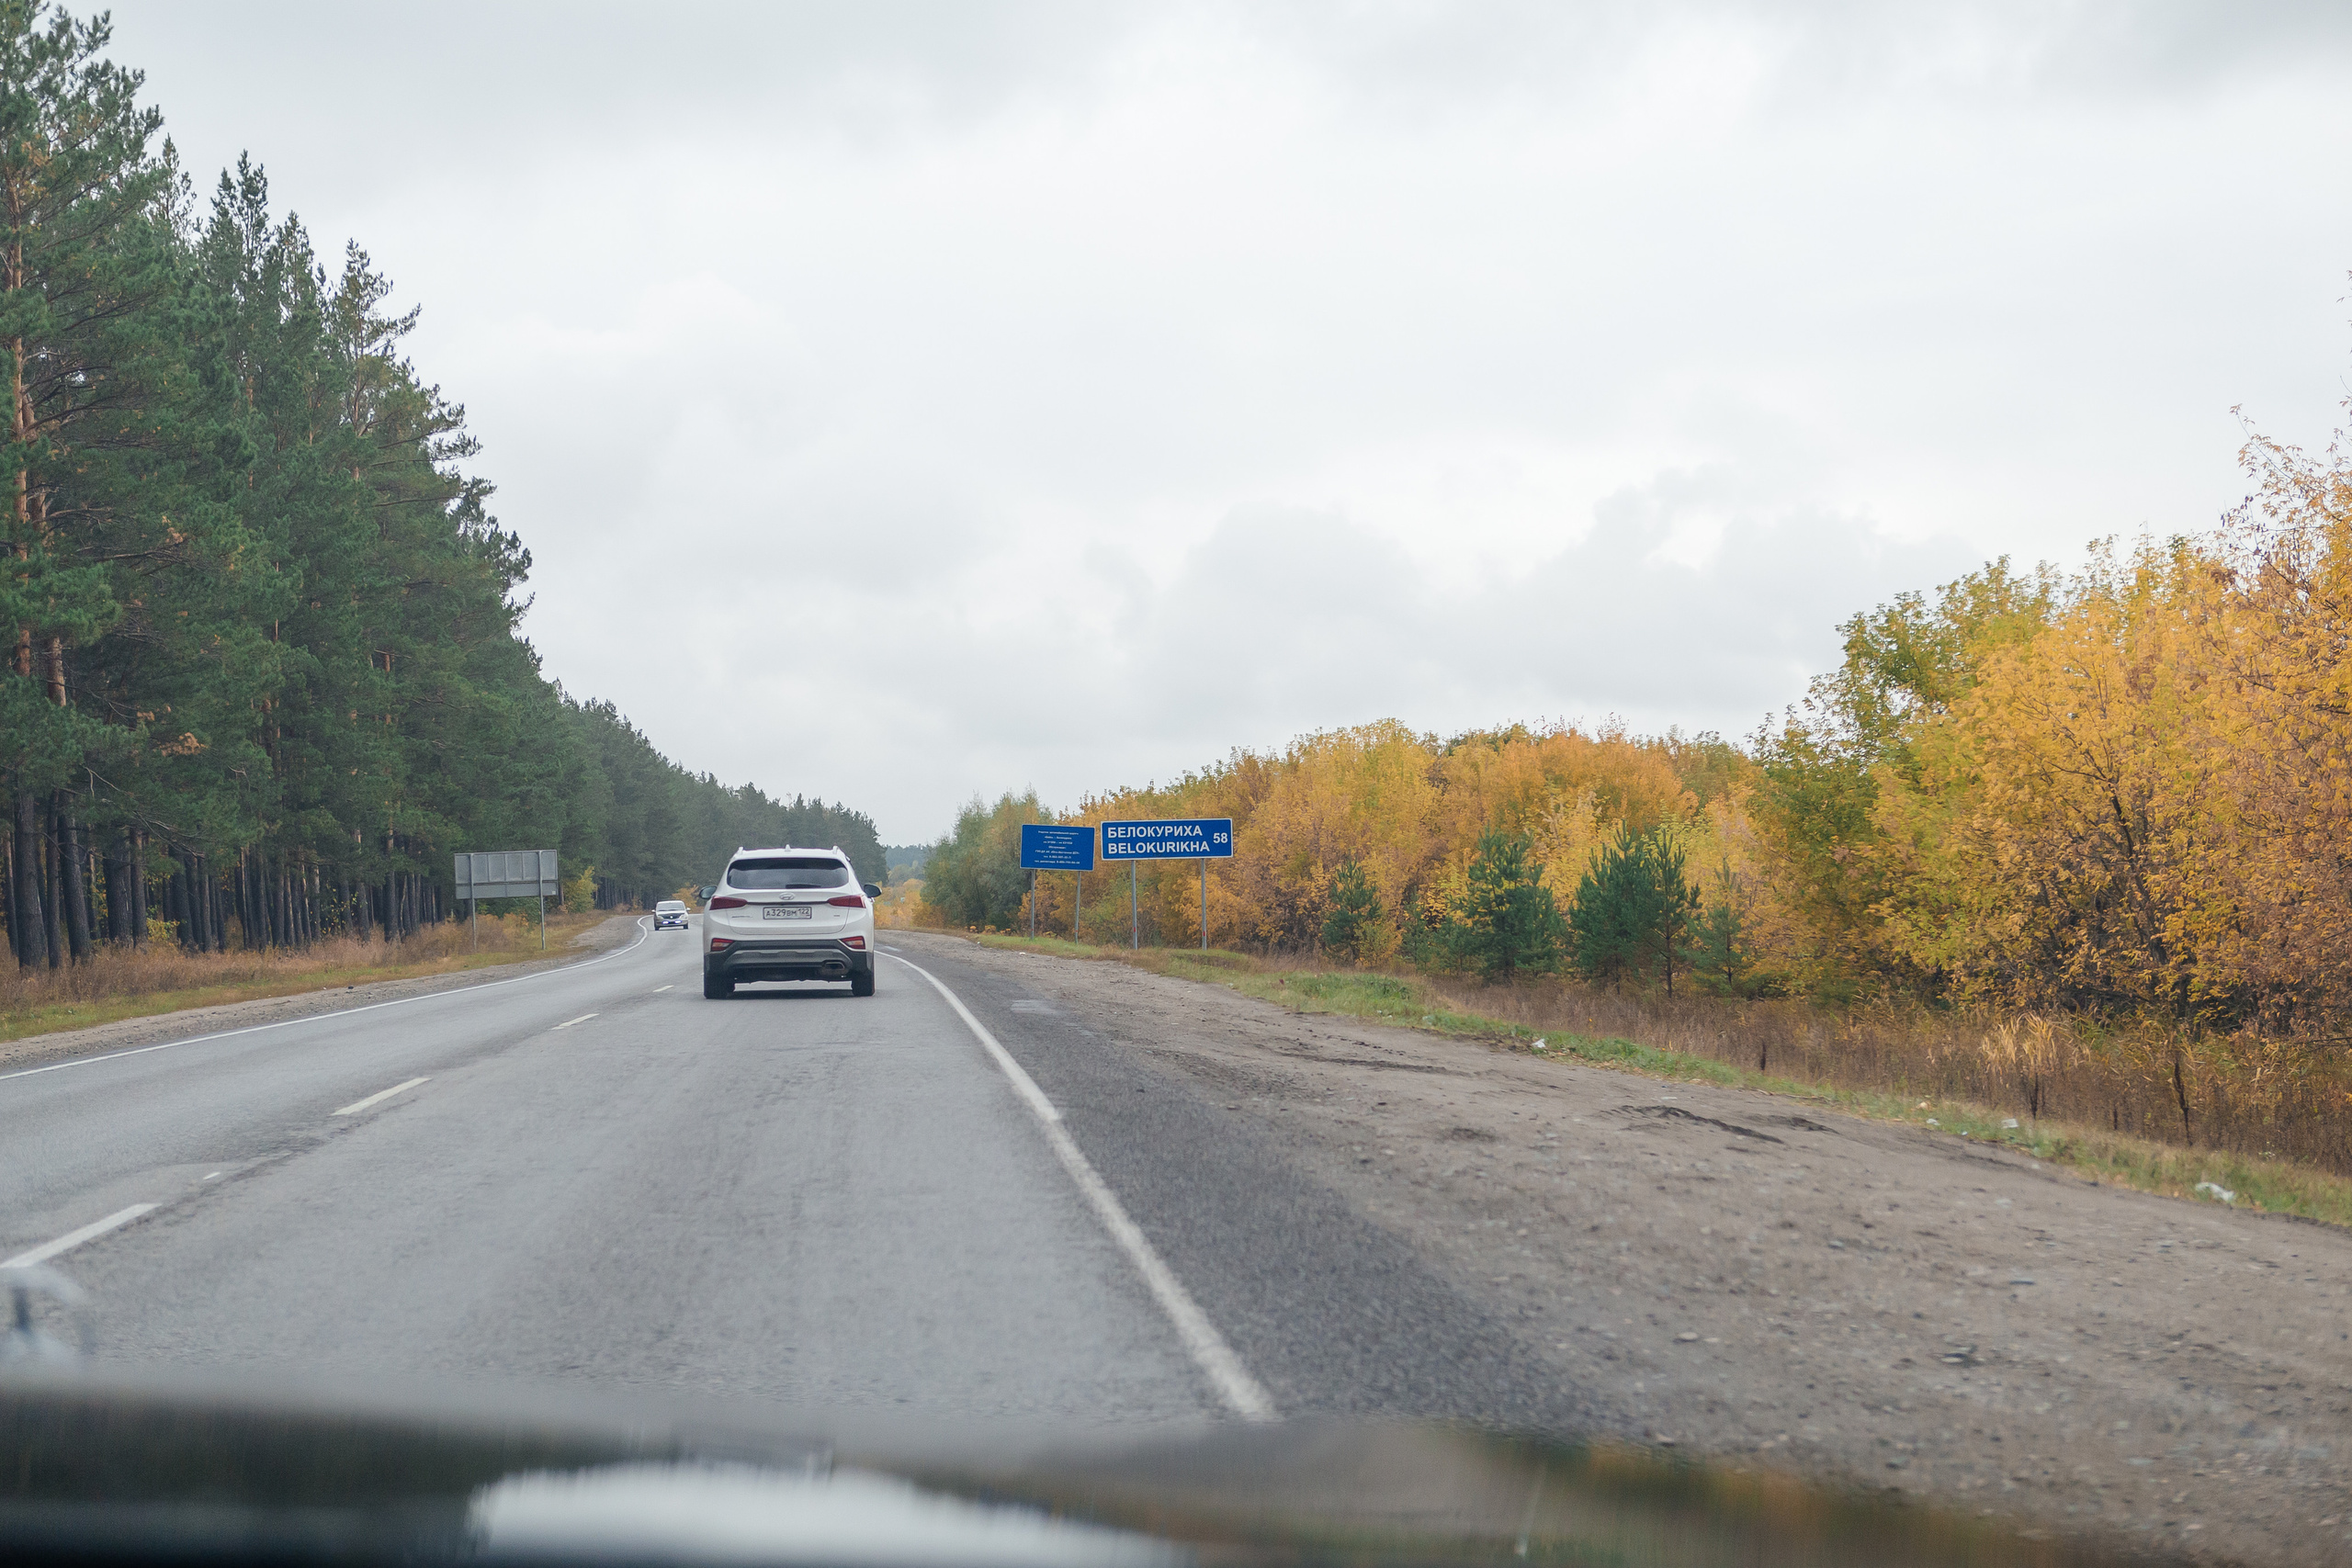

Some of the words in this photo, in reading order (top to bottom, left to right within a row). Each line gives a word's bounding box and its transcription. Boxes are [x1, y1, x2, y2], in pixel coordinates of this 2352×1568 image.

[1107, 825, 1203, 839] БЕЛОКУРИХА
[1213, 832, 1228, 844] 58
[1108, 840, 1210, 854] BELOKURIKHA
